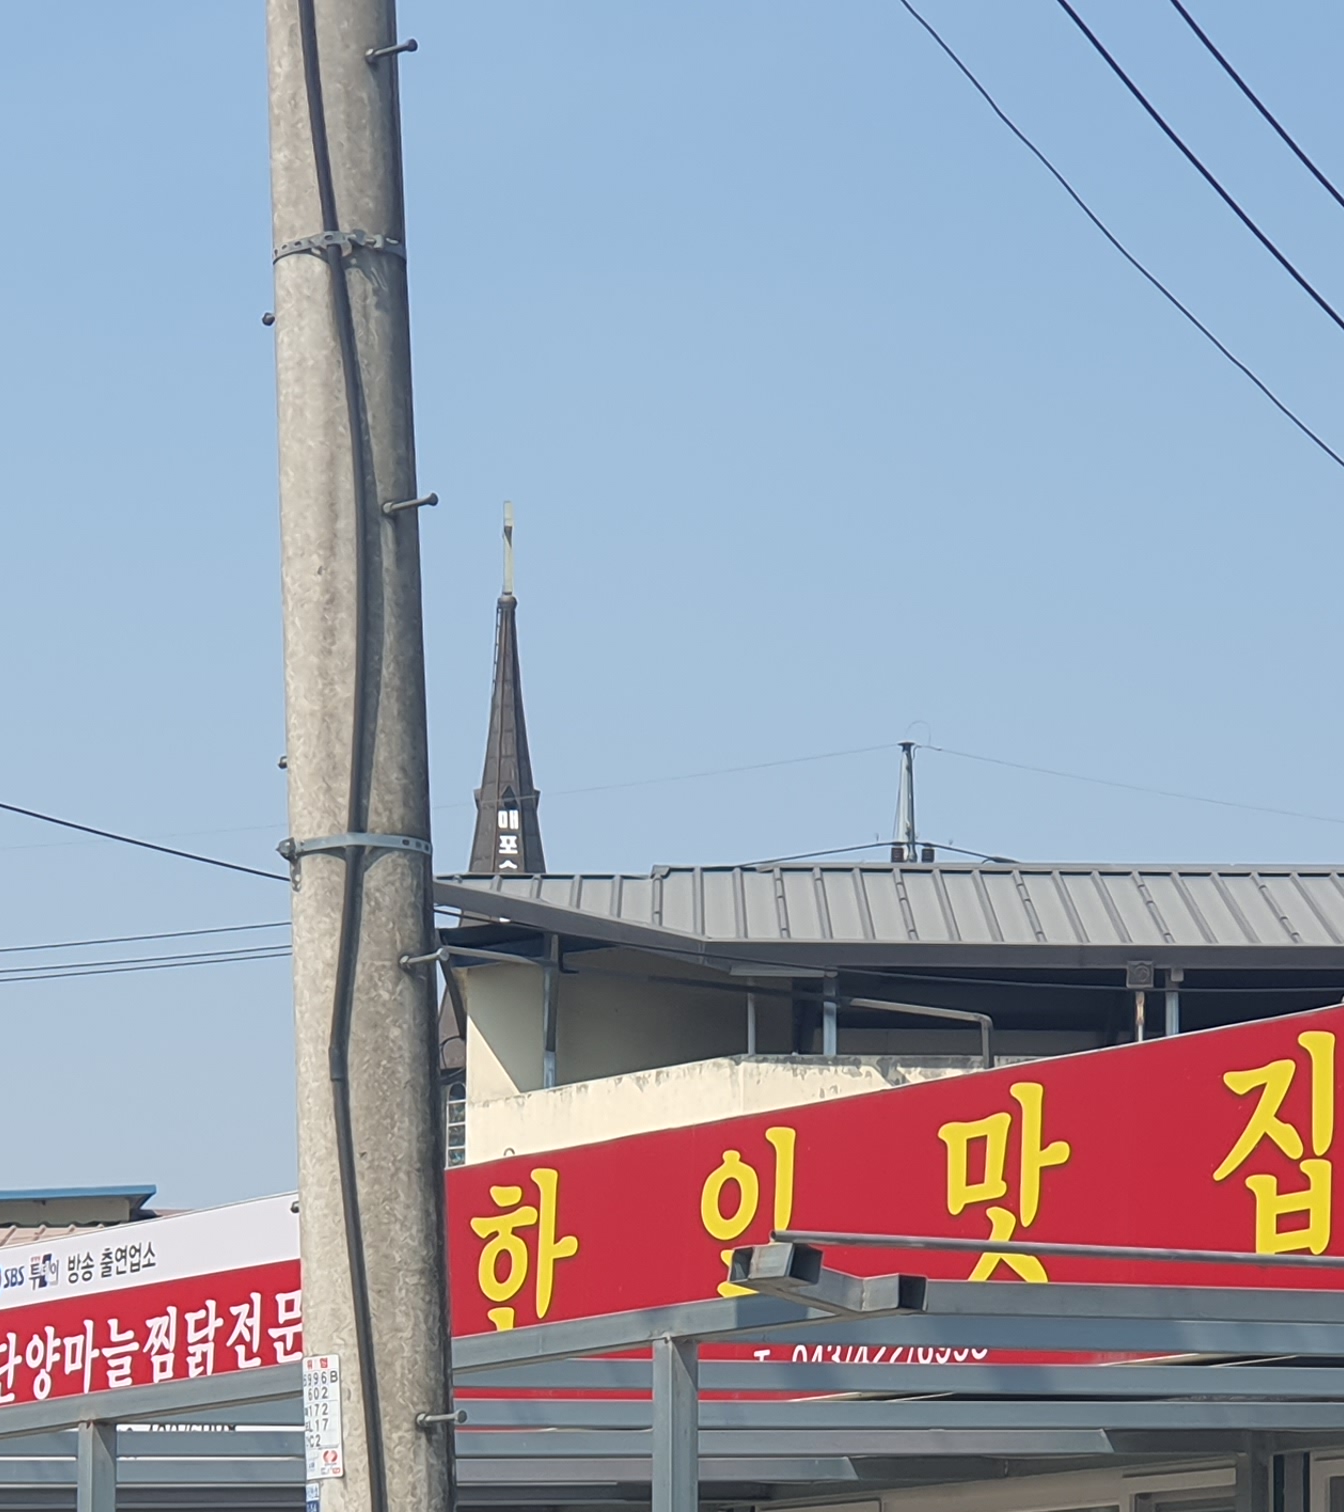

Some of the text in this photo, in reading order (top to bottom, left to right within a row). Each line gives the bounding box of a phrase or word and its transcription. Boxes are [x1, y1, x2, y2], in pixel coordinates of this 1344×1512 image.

[3, 1265, 25, 1288] SBS
[67, 1251, 94, 1284] 방송
[100, 1241, 156, 1279] 출연업소
